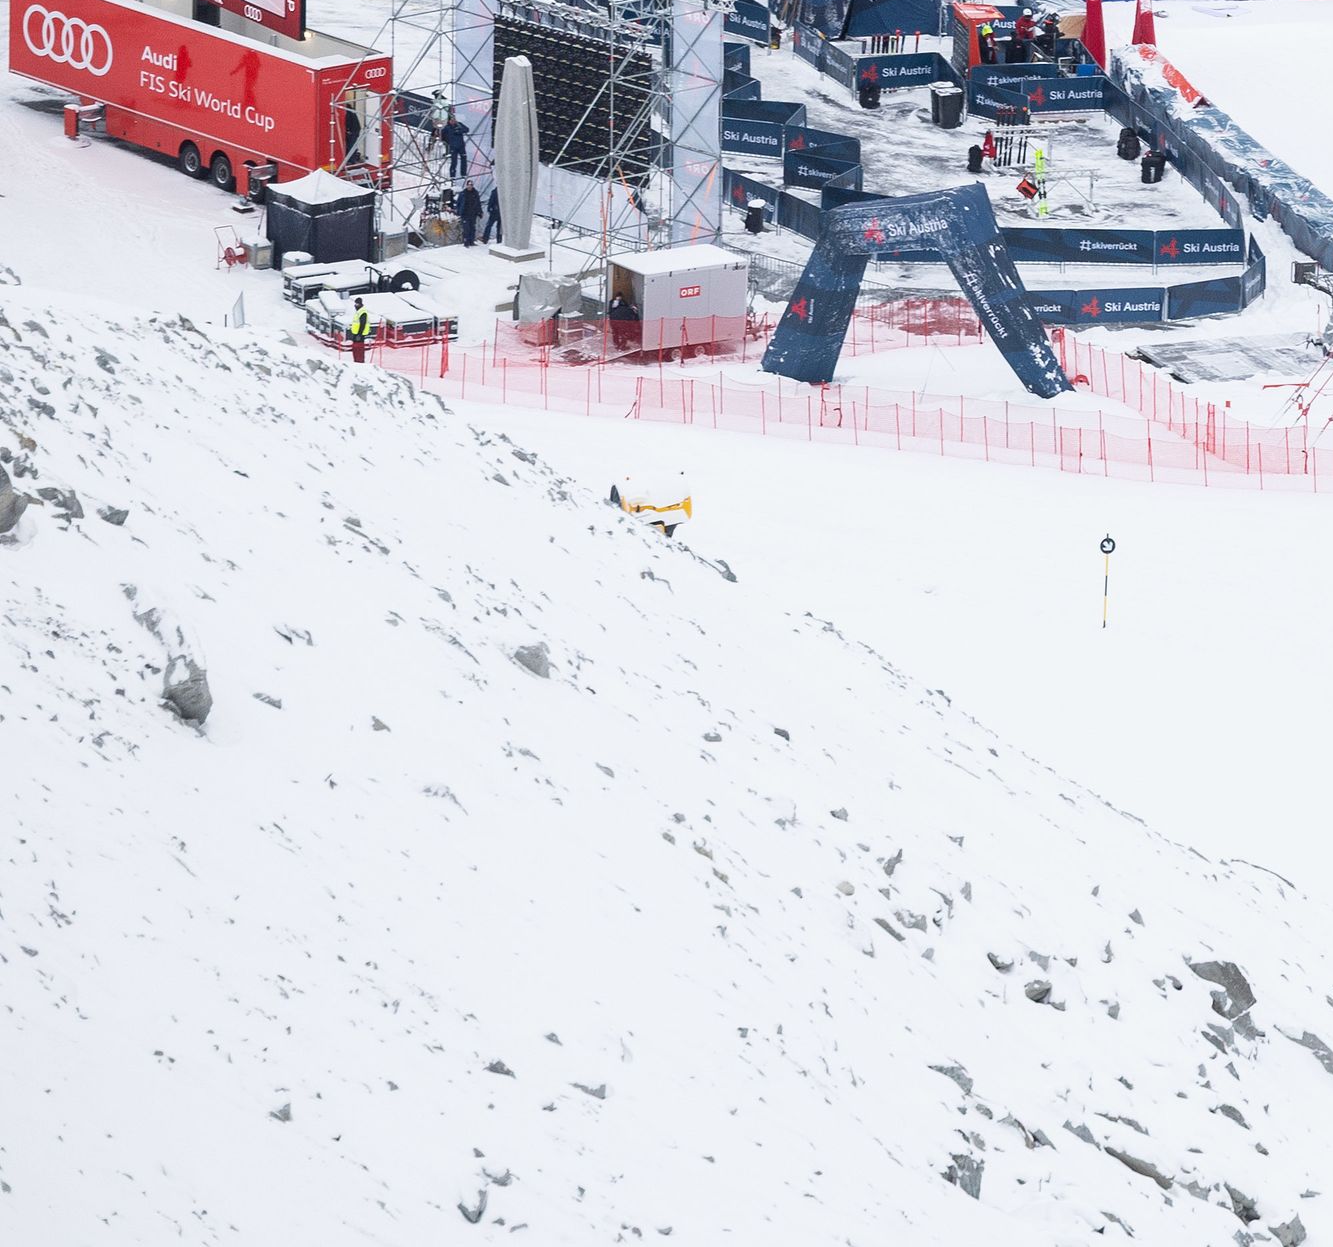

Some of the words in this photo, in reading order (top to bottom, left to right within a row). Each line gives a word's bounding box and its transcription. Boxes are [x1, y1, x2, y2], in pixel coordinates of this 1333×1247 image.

[729, 14, 741, 23] Ski
[741, 16, 767, 31] Austria
[141, 45, 178, 72] Audi
[882, 67, 897, 78] Ski
[899, 64, 932, 77] Austria
[140, 72, 166, 93] FIS
[169, 80, 192, 103] Ski
[193, 87, 242, 120] World
[245, 105, 276, 132] Cup
[1050, 90, 1066, 101] Ski
[1067, 88, 1103, 100] Austria
[723, 130, 742, 142] Ski
[742, 132, 778, 146] Austria
[887, 222, 907, 237] Ski
[909, 217, 949, 234] Austria
[1079, 238, 1138, 251] #skiverrückt
[1183, 243, 1200, 253] Ski
[1202, 242, 1240, 253] Austria
[680, 287, 700, 297] ORF
[963, 271, 1008, 339] #skiverrückt
[1104, 301, 1122, 313] Ski
[1125, 300, 1161, 312] Austria
